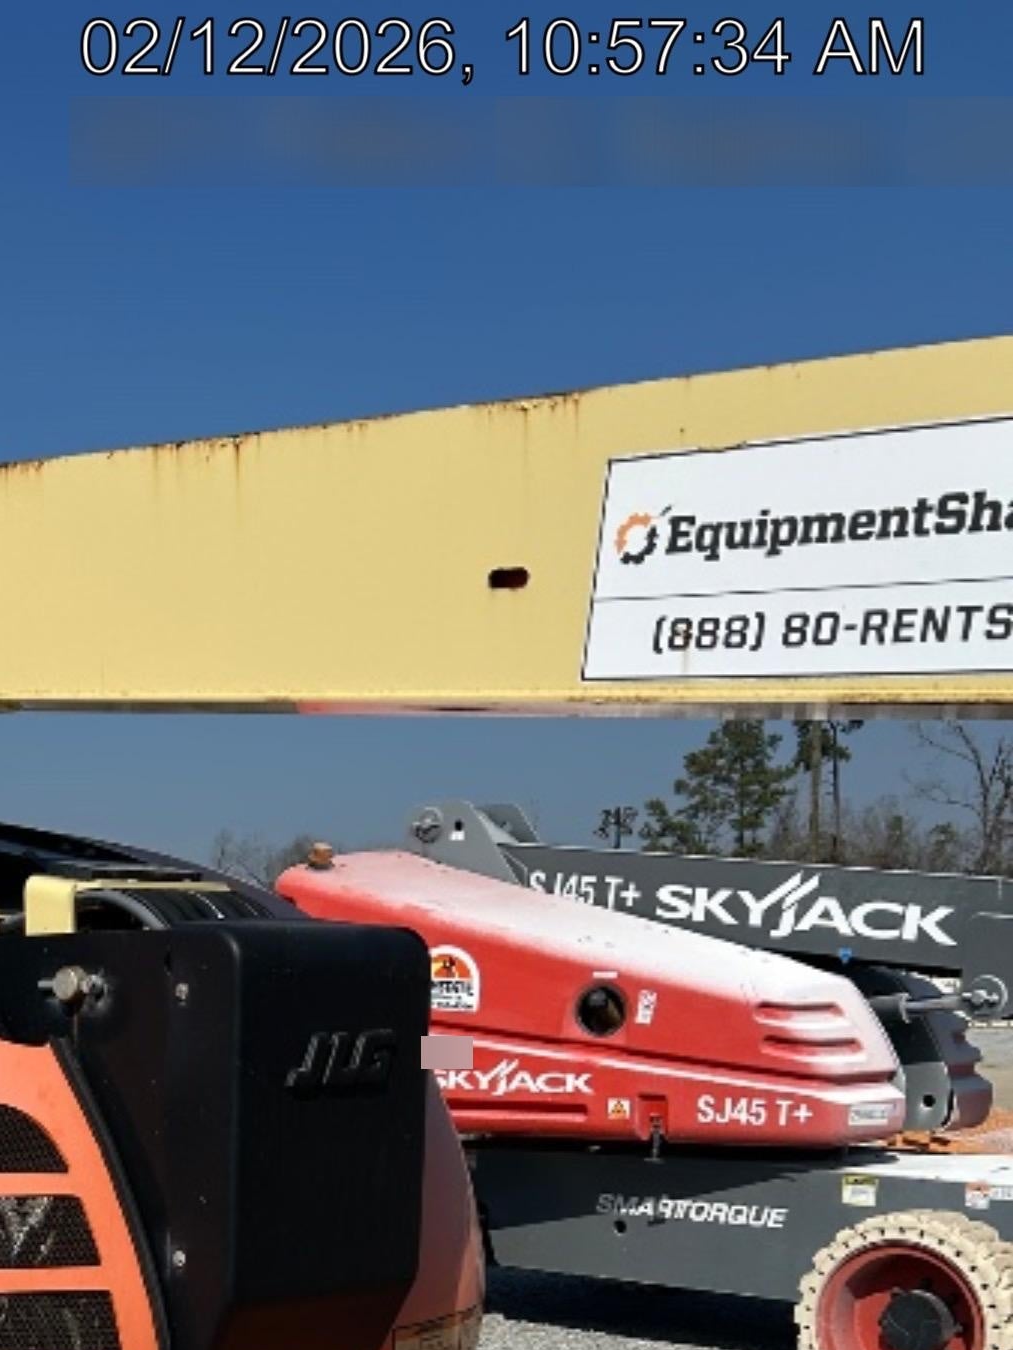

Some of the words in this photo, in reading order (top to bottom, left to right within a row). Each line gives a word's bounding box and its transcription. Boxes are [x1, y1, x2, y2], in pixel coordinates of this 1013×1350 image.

[652, 612, 765, 654] (888)
[782, 602, 1013, 648] 80-RENTS
[605, 875, 642, 911] T+
[656, 870, 958, 947] SKYJACK
[284, 1027, 394, 1087] JLG
[697, 1094, 766, 1126] SJ45
[776, 1099, 814, 1126] T+
[596, 1193, 789, 1229] SMARTORQUE
